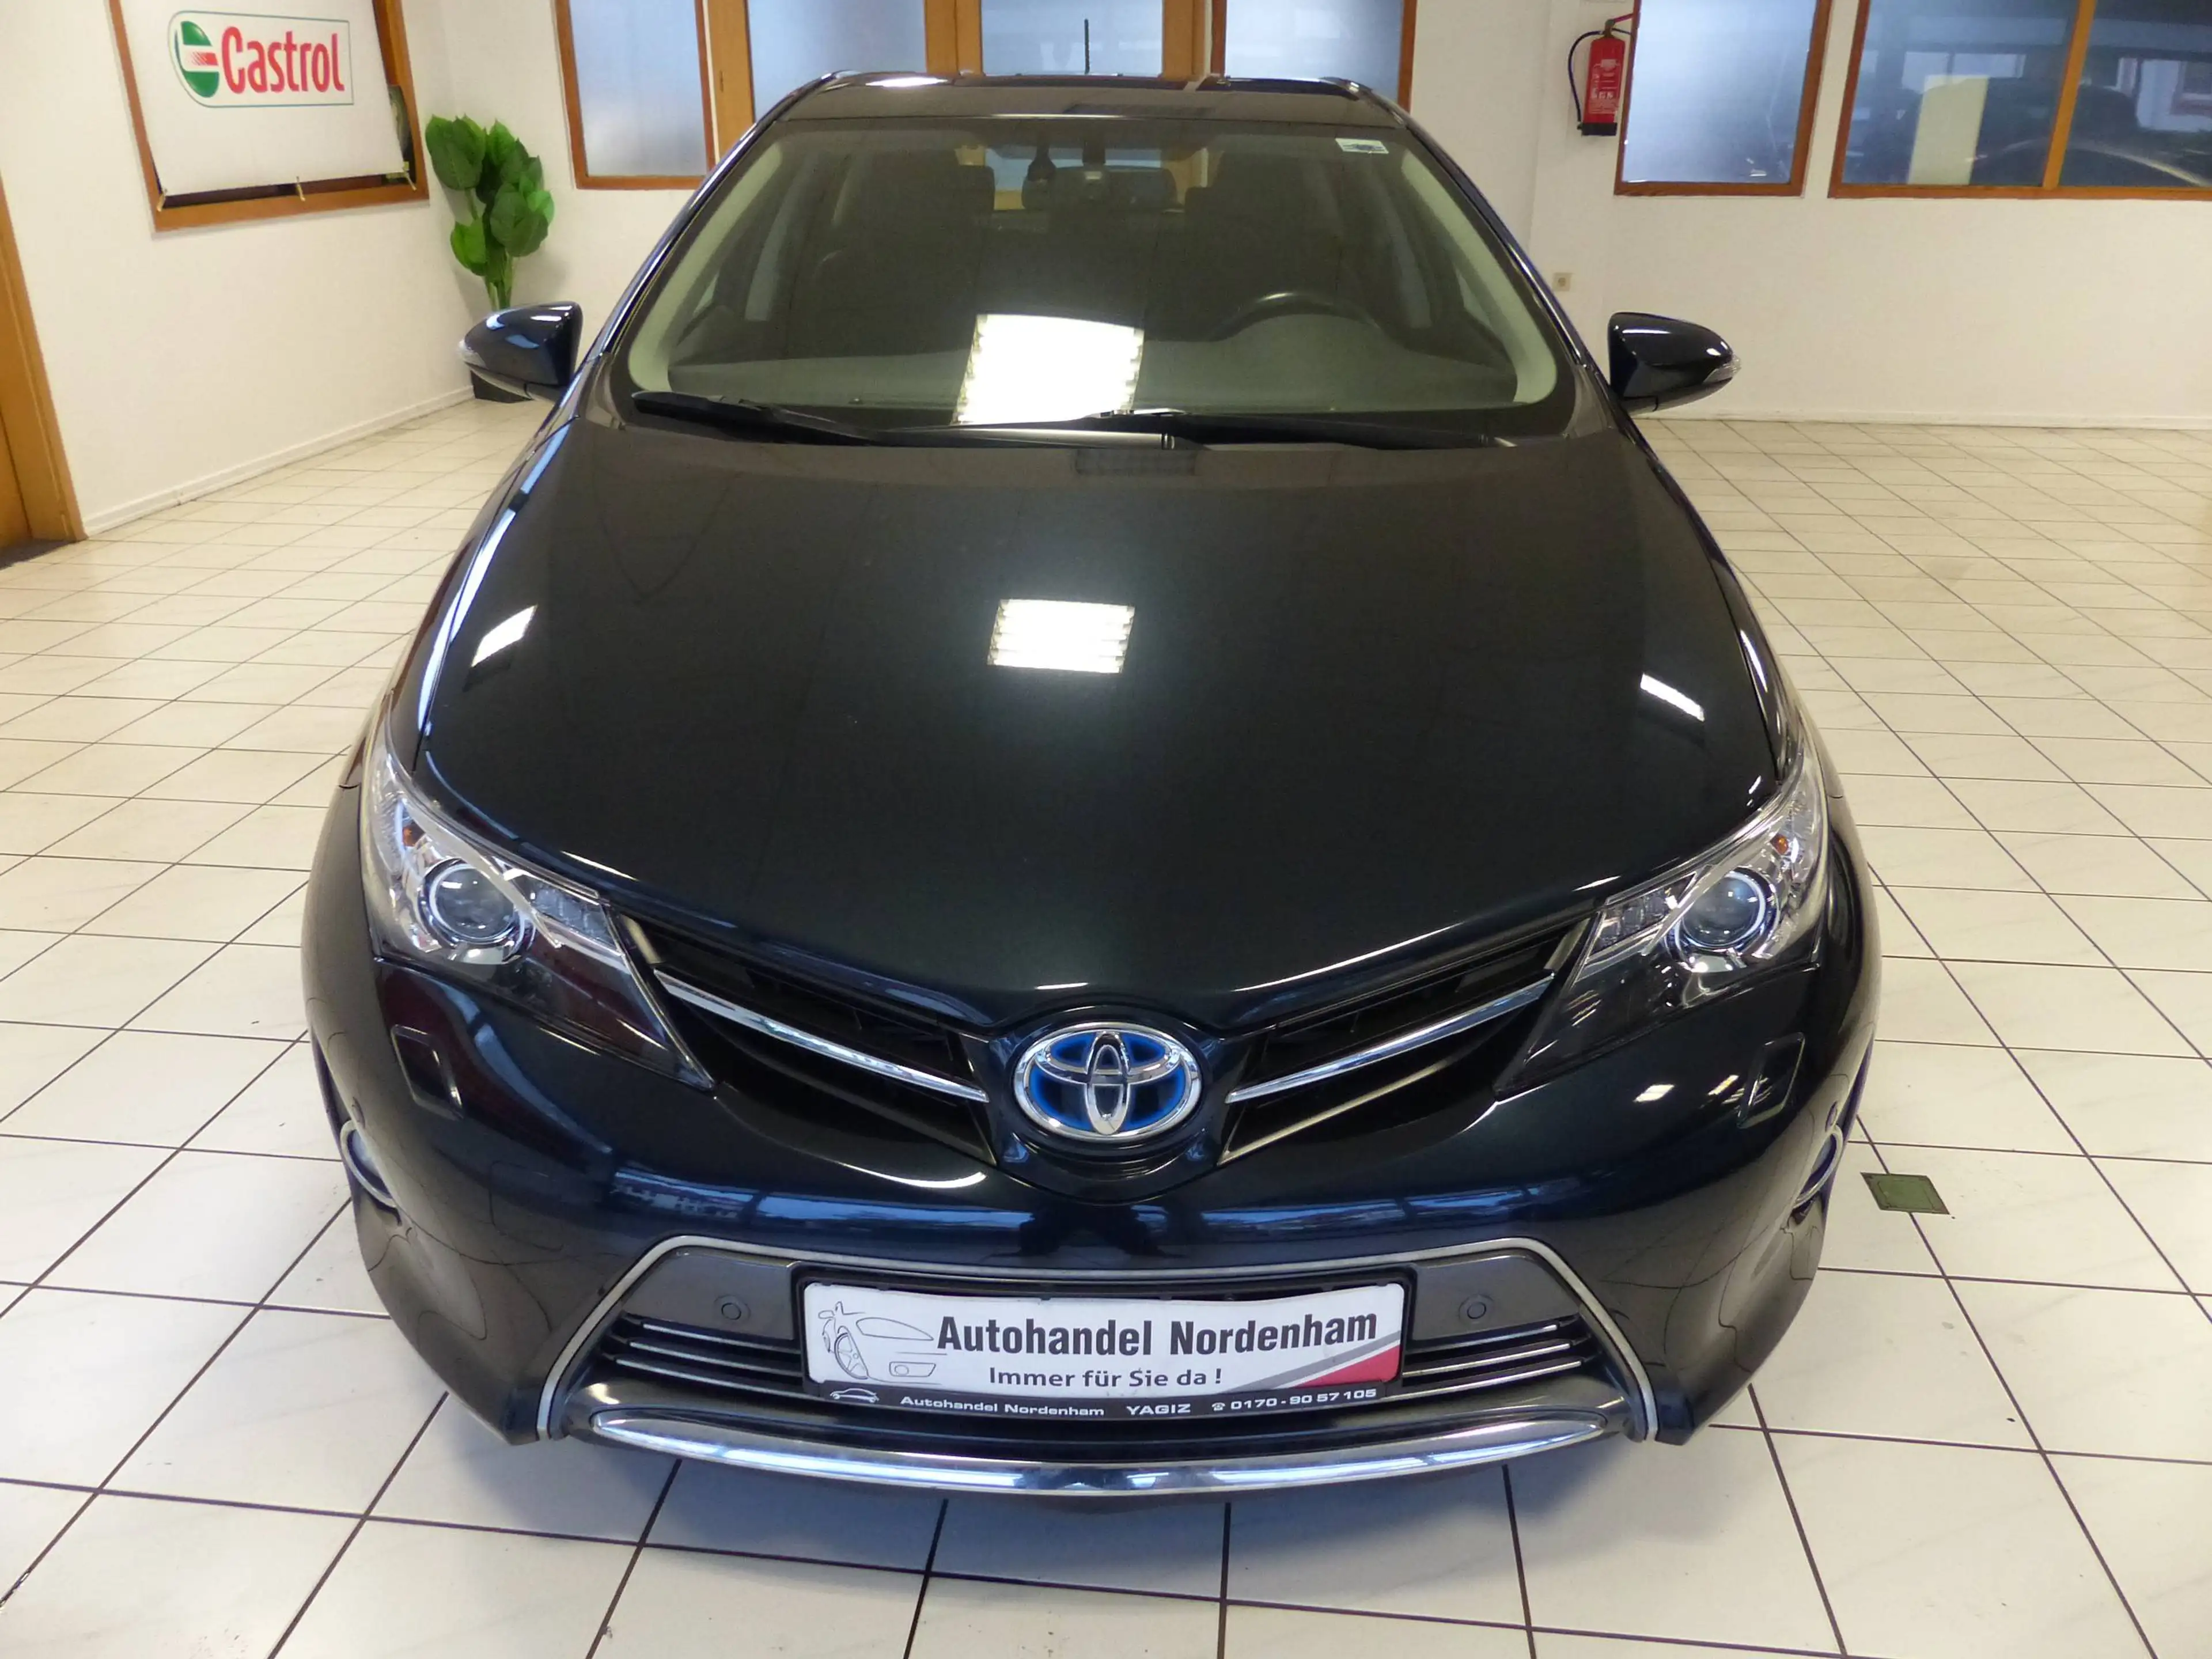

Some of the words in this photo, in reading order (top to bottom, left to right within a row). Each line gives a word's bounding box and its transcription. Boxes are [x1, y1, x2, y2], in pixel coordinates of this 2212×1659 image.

[221, 26, 345, 94] Castrol
[937, 1316, 1152, 1356] Autohandel
[1170, 1313, 1377, 1355] Nordenham
[989, 1367, 1075, 1387] Immer
[1082, 1370, 1122, 1387] für
[1128, 1368, 1169, 1387] Sie
[1176, 1369, 1207, 1386] da
[900, 1396, 998, 1413] Autohandel
[1004, 1404, 1105, 1416] Nordenham
[1126, 1403, 1191, 1416] YAGIZ
[1230, 1398, 1278, 1410] 0170
[1343, 1388, 1377, 1400] 105
